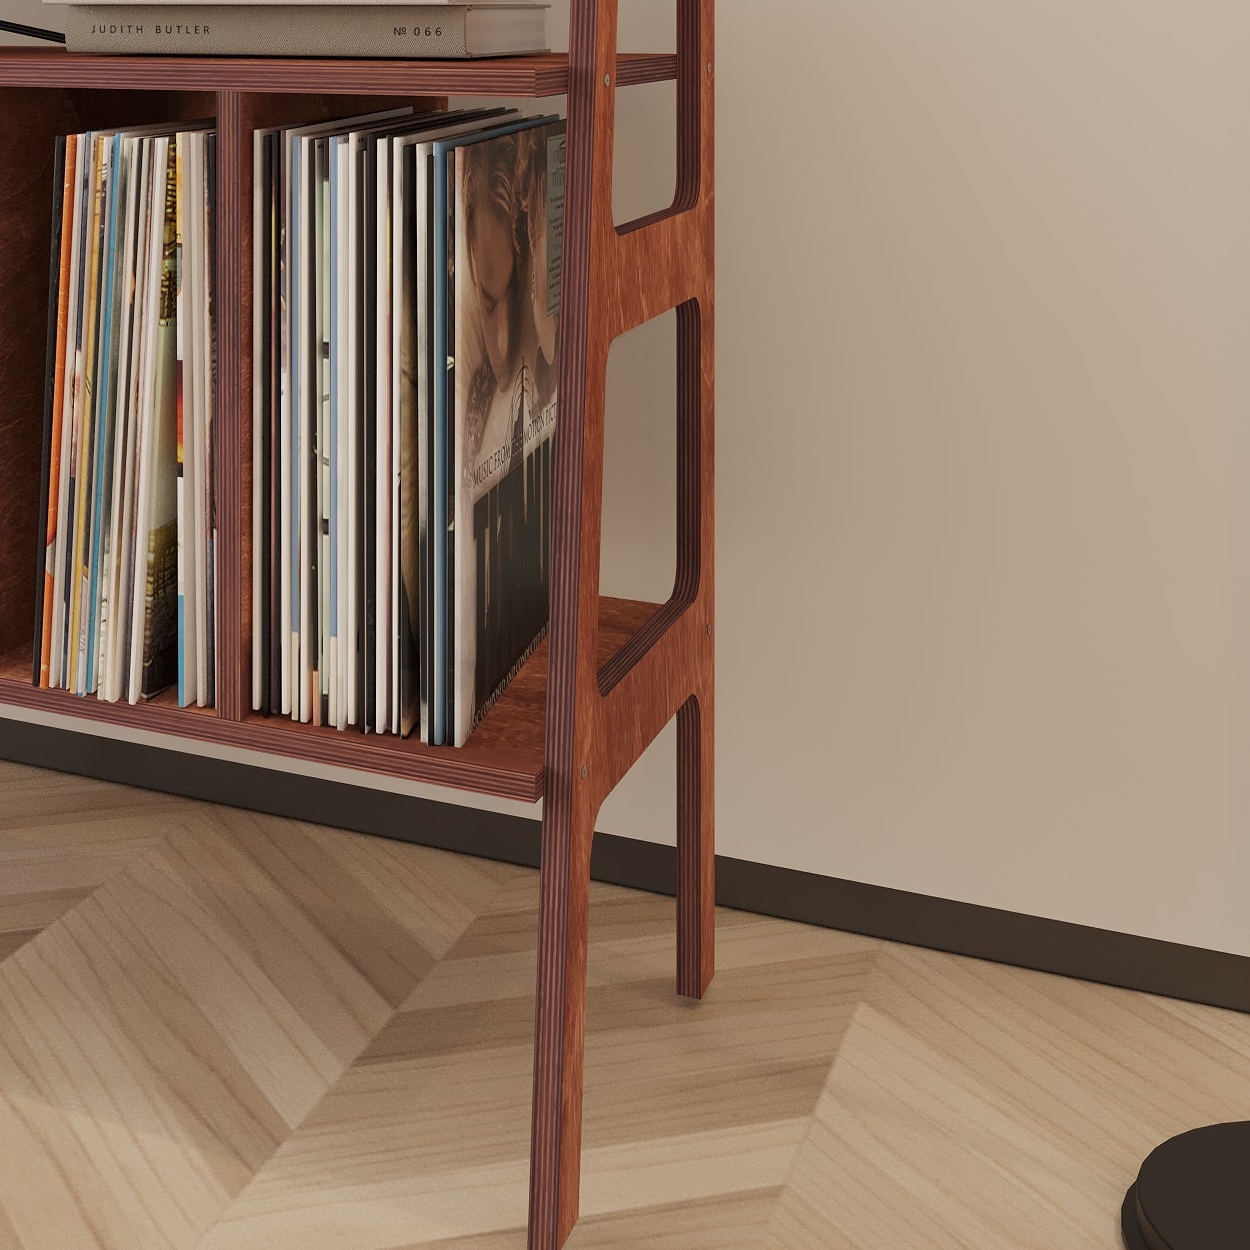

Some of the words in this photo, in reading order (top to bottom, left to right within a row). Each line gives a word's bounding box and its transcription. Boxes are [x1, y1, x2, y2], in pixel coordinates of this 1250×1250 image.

[91, 24, 144, 35] JUDITH
[155, 24, 211, 35] BUTLER
[413, 26, 442, 36] 066
[473, 455, 493, 486] MUSIC
[494, 444, 511, 470] FROM
[524, 411, 544, 443] MOTION
